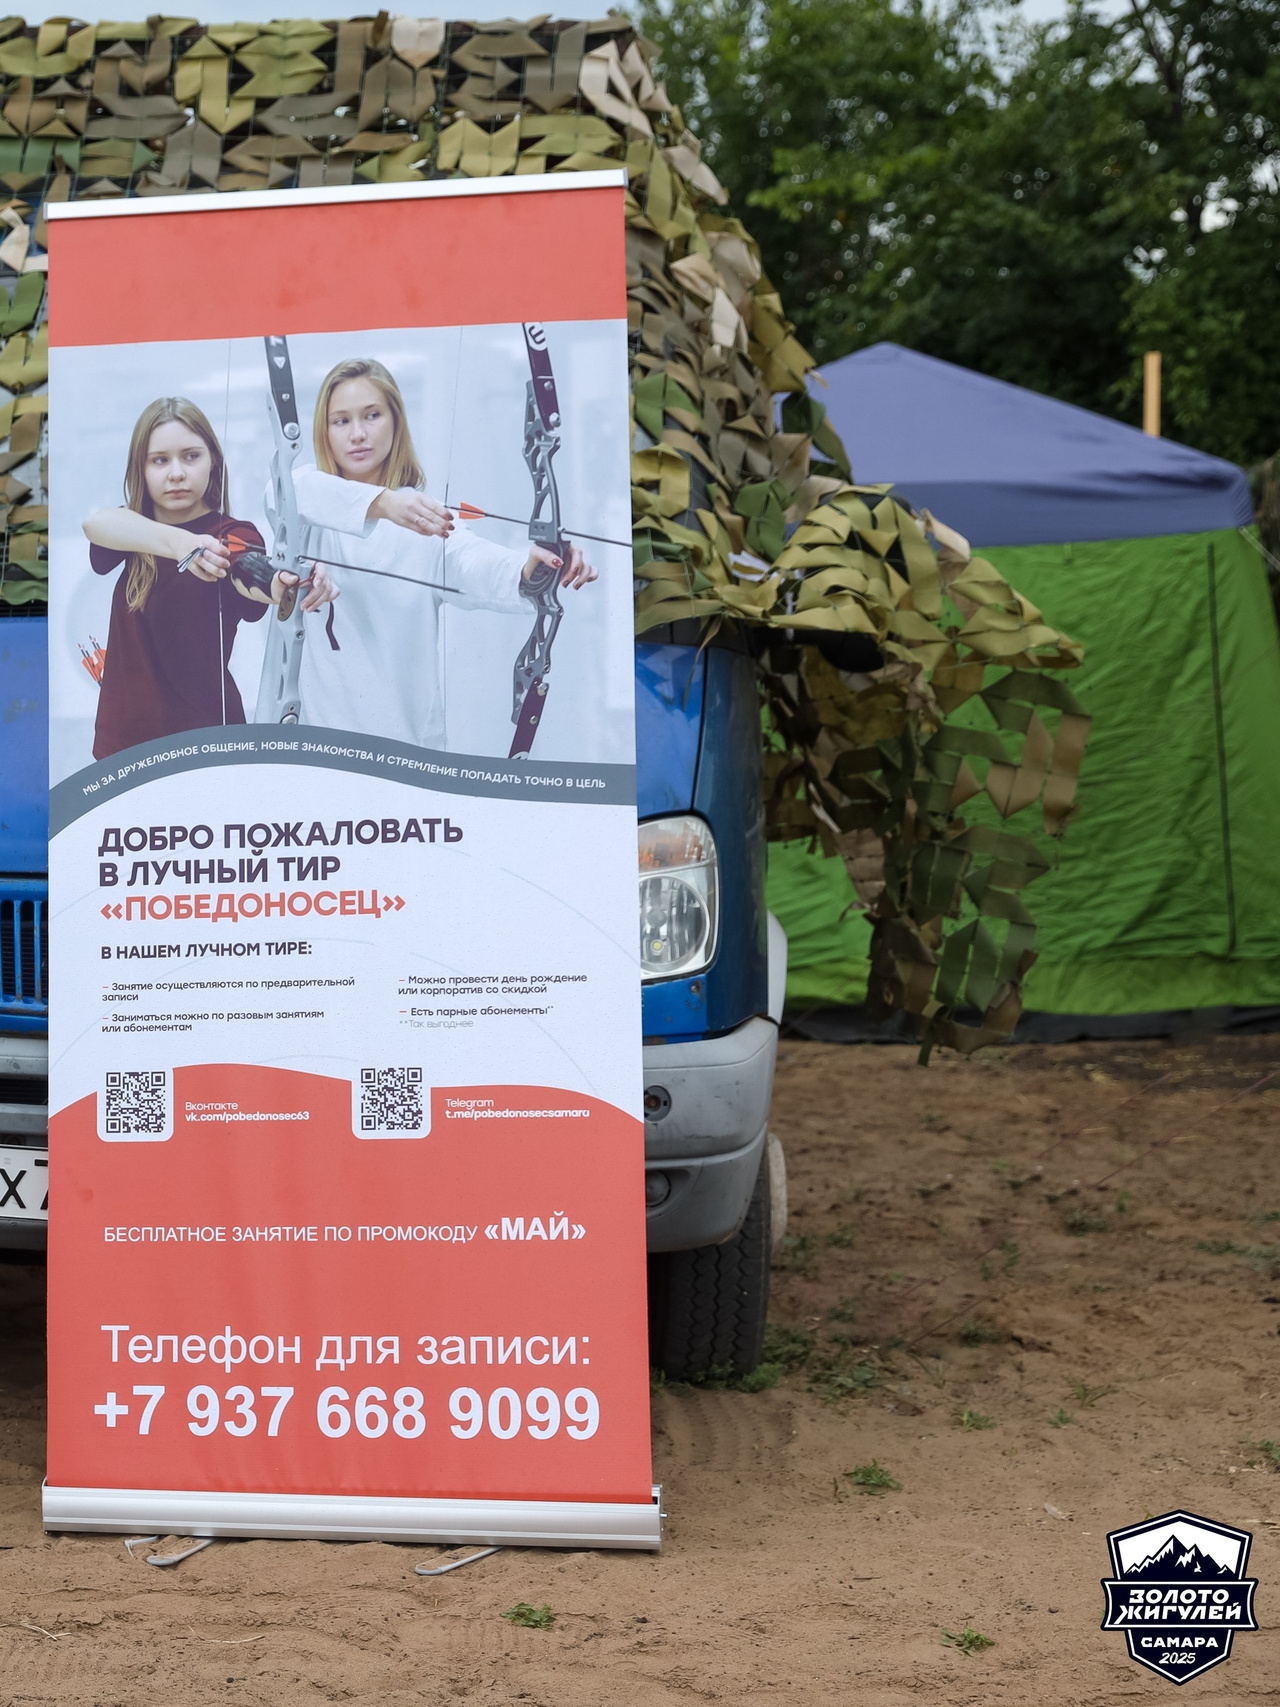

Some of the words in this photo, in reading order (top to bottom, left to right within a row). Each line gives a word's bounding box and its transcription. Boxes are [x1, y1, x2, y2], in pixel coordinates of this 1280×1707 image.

[83, 782, 101, 795] МЫ
[101, 774, 116, 786] ЗА
[117, 745, 199, 780] ДРУЖЕЛЮБНОЕ
[201, 742, 258, 753] ОБЩЕНИЕ,
[262, 741, 299, 751] НОВЫЕ
[302, 742, 374, 761] ЗНАКОМСТВА
[377, 754, 384, 762] И
[387, 755, 457, 777] СТРЕМЛЕНИЕ
[460, 769, 521, 784] ПОПАДАТЬ
[525, 776, 562, 787] ТОЧНО
[566, 778, 572, 787] В
[576, 778, 606, 789] ЦЕЛЬ
[98, 825, 214, 856] ДОБРО
[224, 818, 464, 849] ПОЖАЛОВАТЬ
[99, 862, 118, 886] В
[127, 849, 268, 886] ЛУЧНЫЙ
[277, 856, 341, 881] ТИР
[100, 889, 406, 923] «ПОБЕДОНОСЕЦ»
[101, 946, 111, 959] В
[117, 945, 181, 959] НАШЕМ
[185, 943, 260, 957] ЛУЧНОМ
[265, 941, 312, 956] ТИРЕ:
[112, 981, 153, 991] Занятие
[155, 980, 243, 992] осуществляются
[246, 980, 259, 988] по
[261, 977, 355, 990] предварительной
[409, 975, 446, 985] Можно
[449, 975, 499, 986] провести
[501, 974, 527, 984] день
[530, 973, 587, 985] рождение
[102, 993, 138, 1001] записи
[398, 987, 418, 995] или
[420, 986, 483, 997] корпоратив
[502, 984, 547, 995] скидкой
[112, 1012, 172, 1022] Заниматься
[174, 1012, 209, 1020] можно
[212, 1012, 224, 1020] по
[227, 1011, 273, 1021] разовым
[276, 1010, 324, 1019] занятиям
[411, 1007, 434, 1017] Есть
[436, 1007, 477, 1018] парные
[102, 1025, 121, 1033] или
[123, 1023, 192, 1032] абонементам
[185, 1101, 238, 1111] Вконтакте
[446, 1098, 494, 1109] Telegram
[185, 1111, 309, 1123] vk.com/pobedonosec63
[445, 1108, 590, 1120] t.me/pobedonosecsamara
[104, 1225, 226, 1242] БЕСПЛАТНОЕ
[232, 1225, 318, 1242] ЗАНЯТИЕ
[324, 1225, 352, 1242] ПО
[357, 1225, 478, 1244] ПРОМОКОДУ
[484, 1210, 586, 1242] «МАЙ»
[100, 1324, 302, 1373] Телефон
[316, 1335, 400, 1372] для
[417, 1334, 590, 1366] записи:
[94, 1384, 166, 1436] +7
[186, 1384, 294, 1437] 937
[317, 1386, 426, 1439] 668
[448, 1386, 600, 1441] 9099
